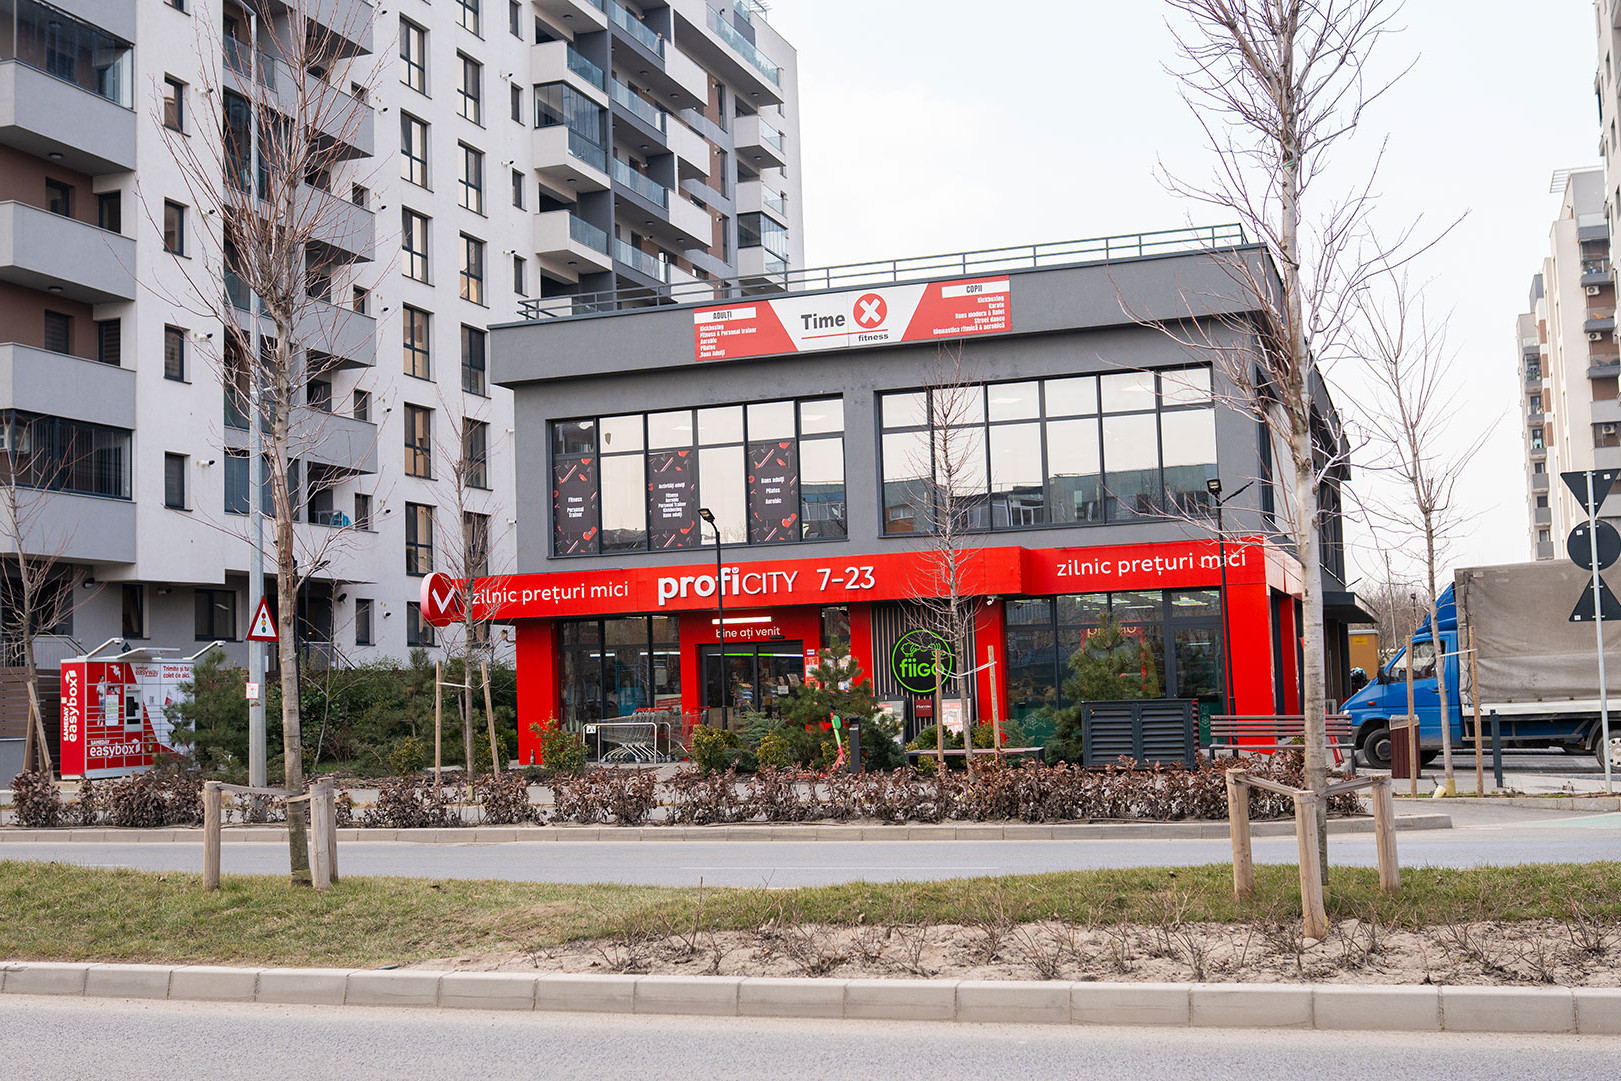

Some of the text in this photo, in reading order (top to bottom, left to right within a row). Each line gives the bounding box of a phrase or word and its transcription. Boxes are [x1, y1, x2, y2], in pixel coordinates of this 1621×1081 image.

[966, 285, 982, 293] COPII
[800, 313, 846, 330] Time
[858, 334, 889, 342] fitness
[1056, 550, 1246, 576] zilnic prețuri mici
[816, 566, 876, 591] 7-23
[472, 581, 628, 605] zilnic prețuri mici
[716, 626, 780, 639] bine ați venit
[68, 678, 79, 742] easybox
[90, 742, 135, 758] easybox
